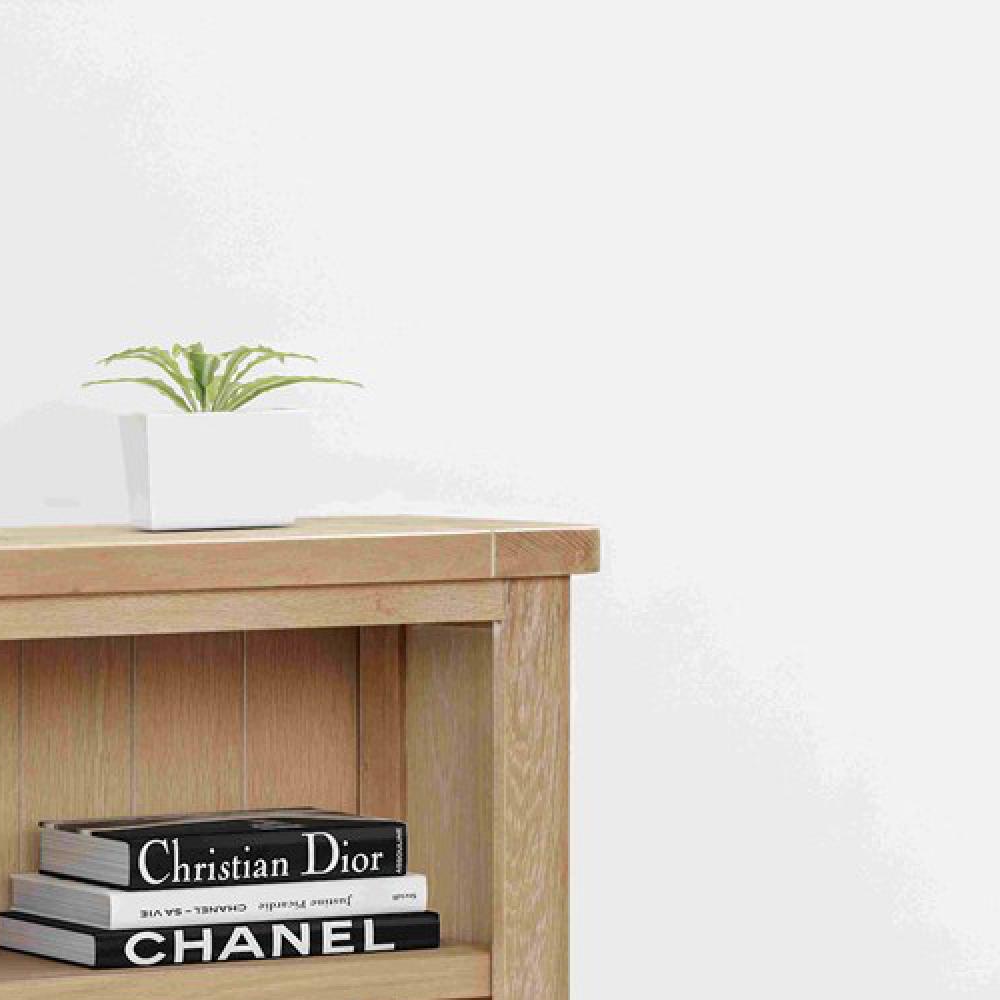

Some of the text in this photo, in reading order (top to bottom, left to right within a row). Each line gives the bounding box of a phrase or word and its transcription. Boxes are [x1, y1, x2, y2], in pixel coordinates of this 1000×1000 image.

[137, 838, 290, 885] Christian
[301, 831, 383, 875] Dior
[257, 899, 307, 912] Picardie
[309, 893, 352, 907] Justine
[139, 908, 162, 918] VIE
[165, 907, 182, 916] SA
[193, 903, 247, 916] CHANEL
[125, 918, 395, 966] CHANEL
